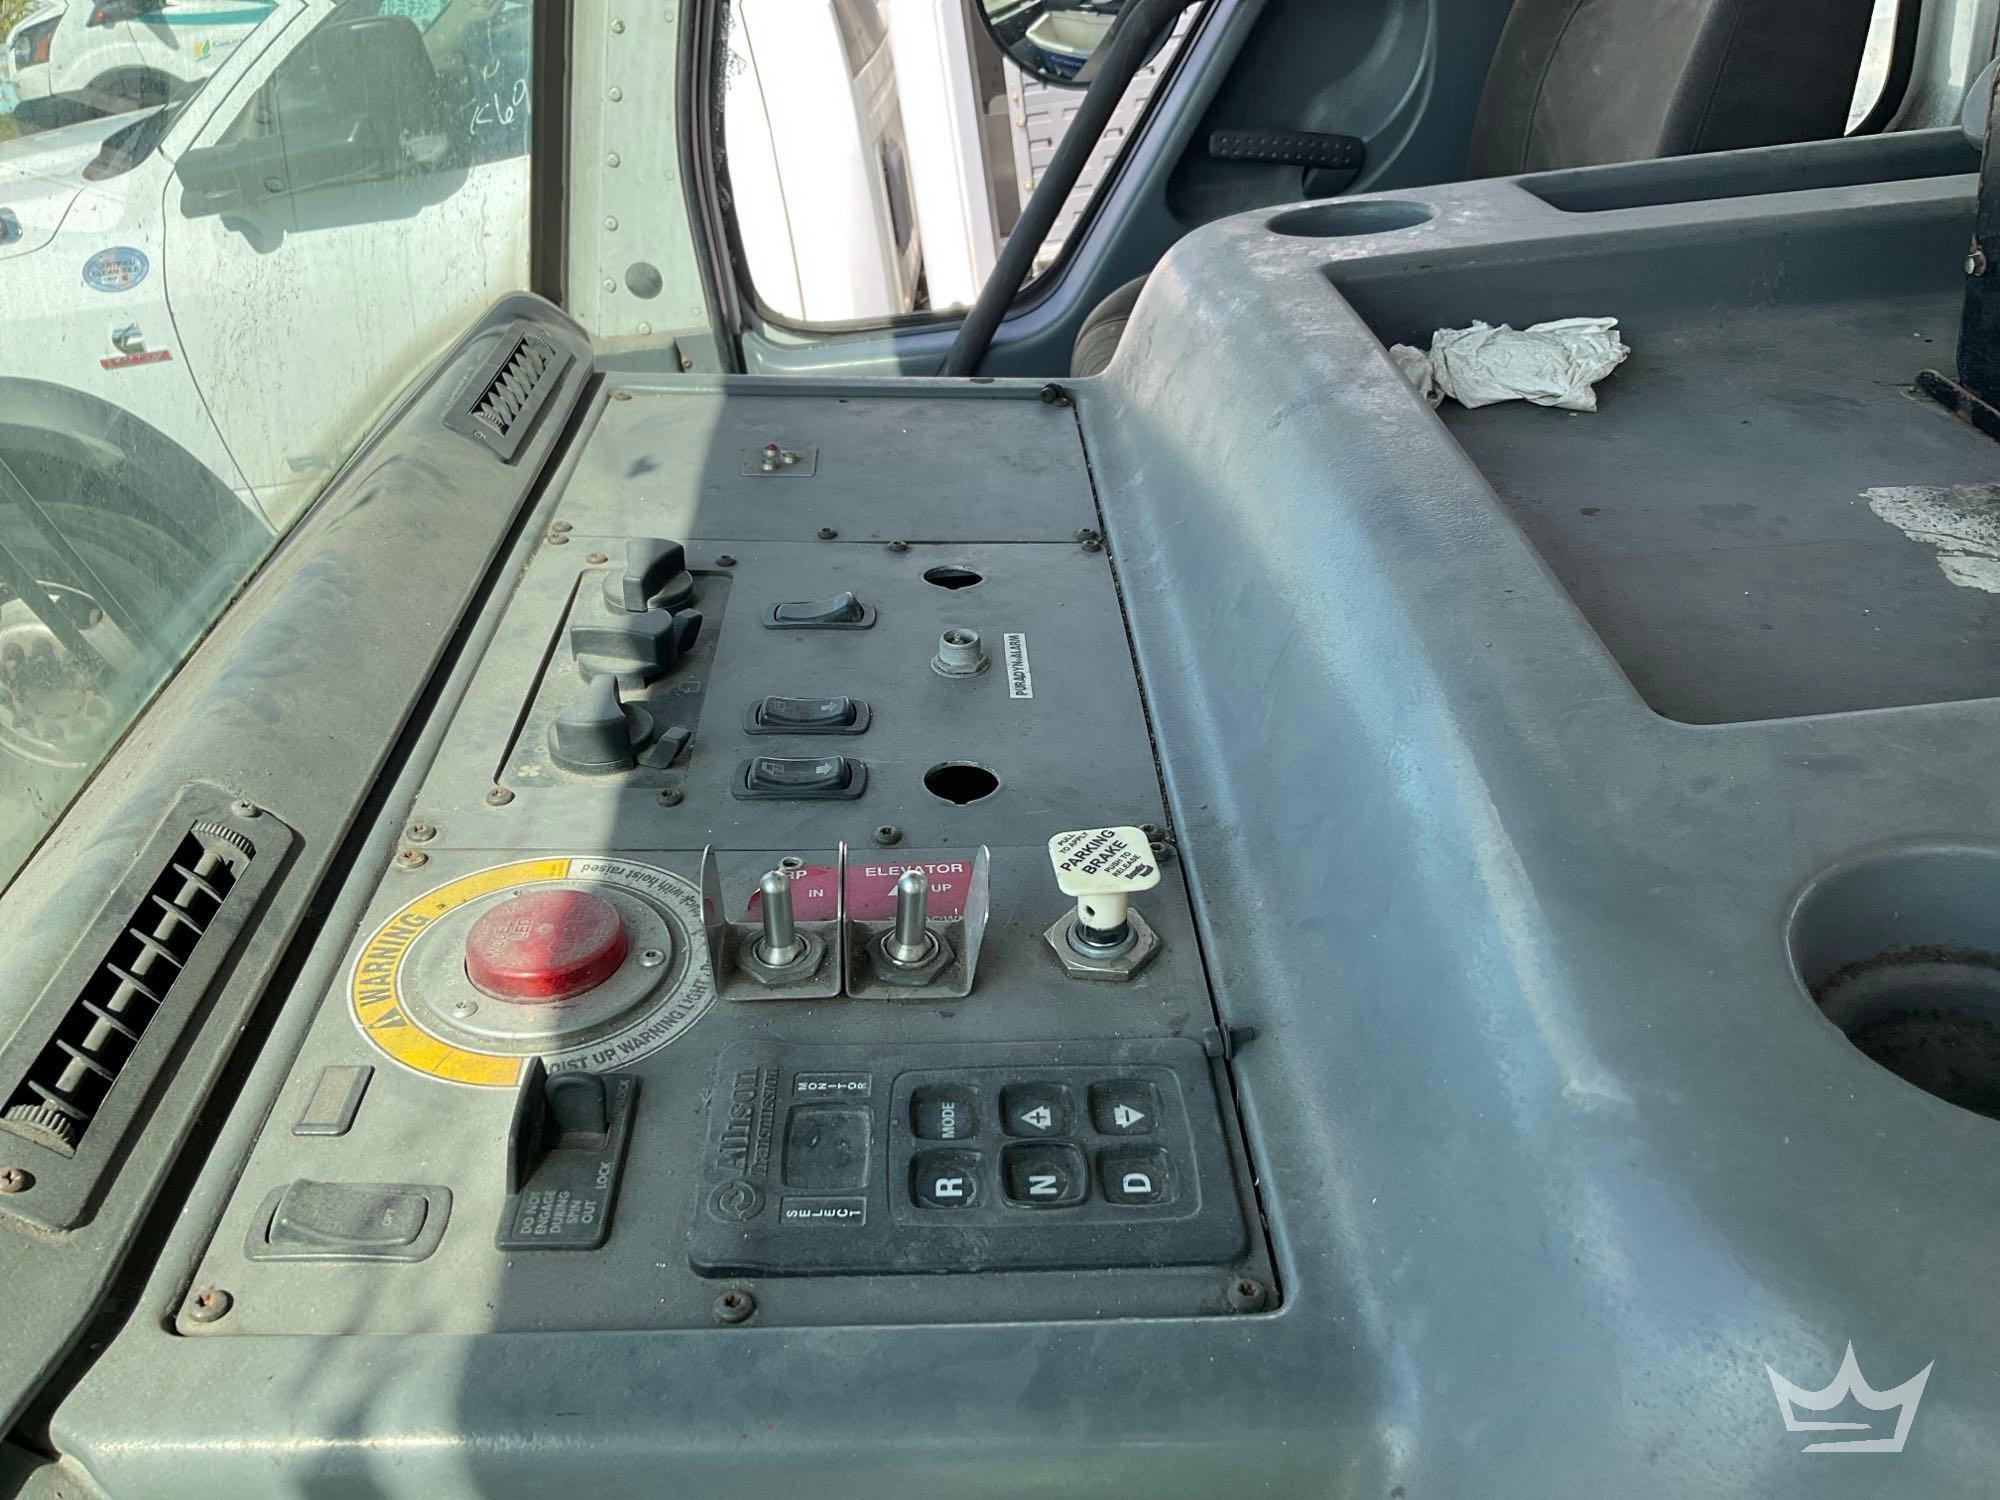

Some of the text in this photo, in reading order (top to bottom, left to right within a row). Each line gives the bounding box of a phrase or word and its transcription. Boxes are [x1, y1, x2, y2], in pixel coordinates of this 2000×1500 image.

[1058, 833, 1076, 846] PULL
[1059, 831, 1088, 854] TO APPLY
[1060, 829, 1116, 872] PARKING
[1082, 839, 1128, 875] BRAKE
[1104, 851, 1131, 873] PUSH TO
[1112, 854, 1141, 877] RELEASE
[581, 863, 626, 877] raised
[625, 869, 660, 889] hoist
[865, 863, 963, 877] ELEVATOR
[808, 888, 825, 898] IN
[930, 883, 952, 893] UP
[359, 912, 430, 1008] WARNING
[549, 1056, 588, 1073] OIST
[592, 1048, 616, 1064] UP
[616, 1008, 686, 1055] WARNING
[797, 1081, 867, 1092] MONITOR
[716, 1066, 759, 1176] Allison
[751, 1068, 779, 1177] Transmission
[941, 1101, 955, 1139] MODE
[595, 1160, 612, 1190] LOCK
[1028, 1175, 1058, 1195] N
[1122, 1172, 1151, 1193] D
[935, 1177, 963, 1197] R
[519, 1191, 542, 1235] DO NOT
[534, 1189, 557, 1235] ENGAGE
[550, 1190, 571, 1234] DURING
[566, 1199, 582, 1225] SPIN
[581, 1200, 597, 1224] OUT
[786, 1209, 861, 1218] SELECT
